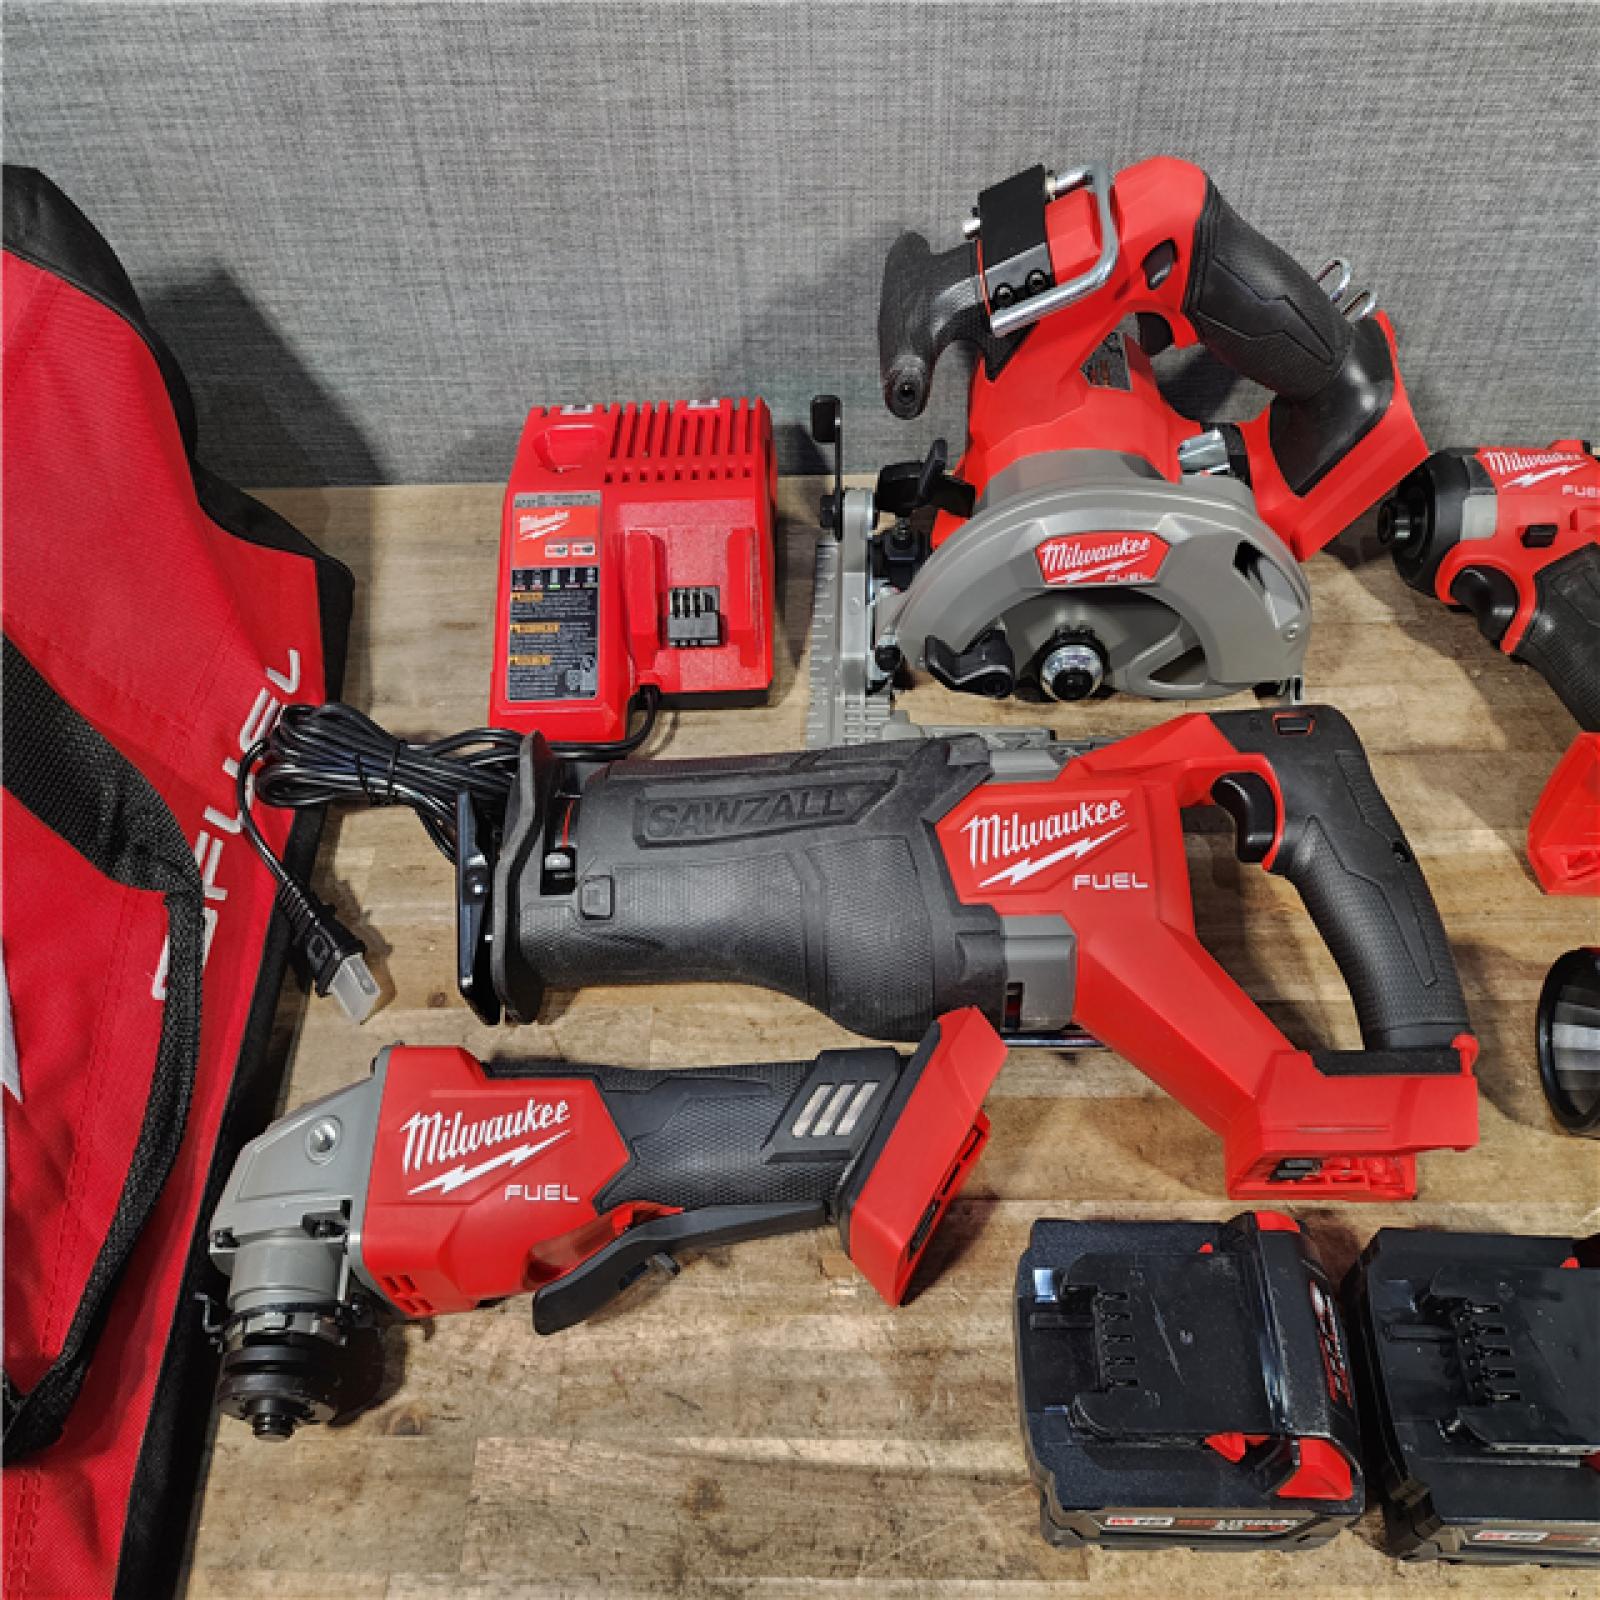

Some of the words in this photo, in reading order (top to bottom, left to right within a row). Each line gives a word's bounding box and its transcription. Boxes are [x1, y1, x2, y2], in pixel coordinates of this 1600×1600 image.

[1561, 484, 1600, 499] FUE
[1039, 536, 1150, 573] Milwaukee
[648, 789, 846, 838] SAWZALL
[959, 799, 1126, 869] Milwaukee
[1072, 872, 1149, 891] FUEL
[399, 1096, 571, 1175] Milwaukee
[504, 1183, 581, 1203] FUEL
